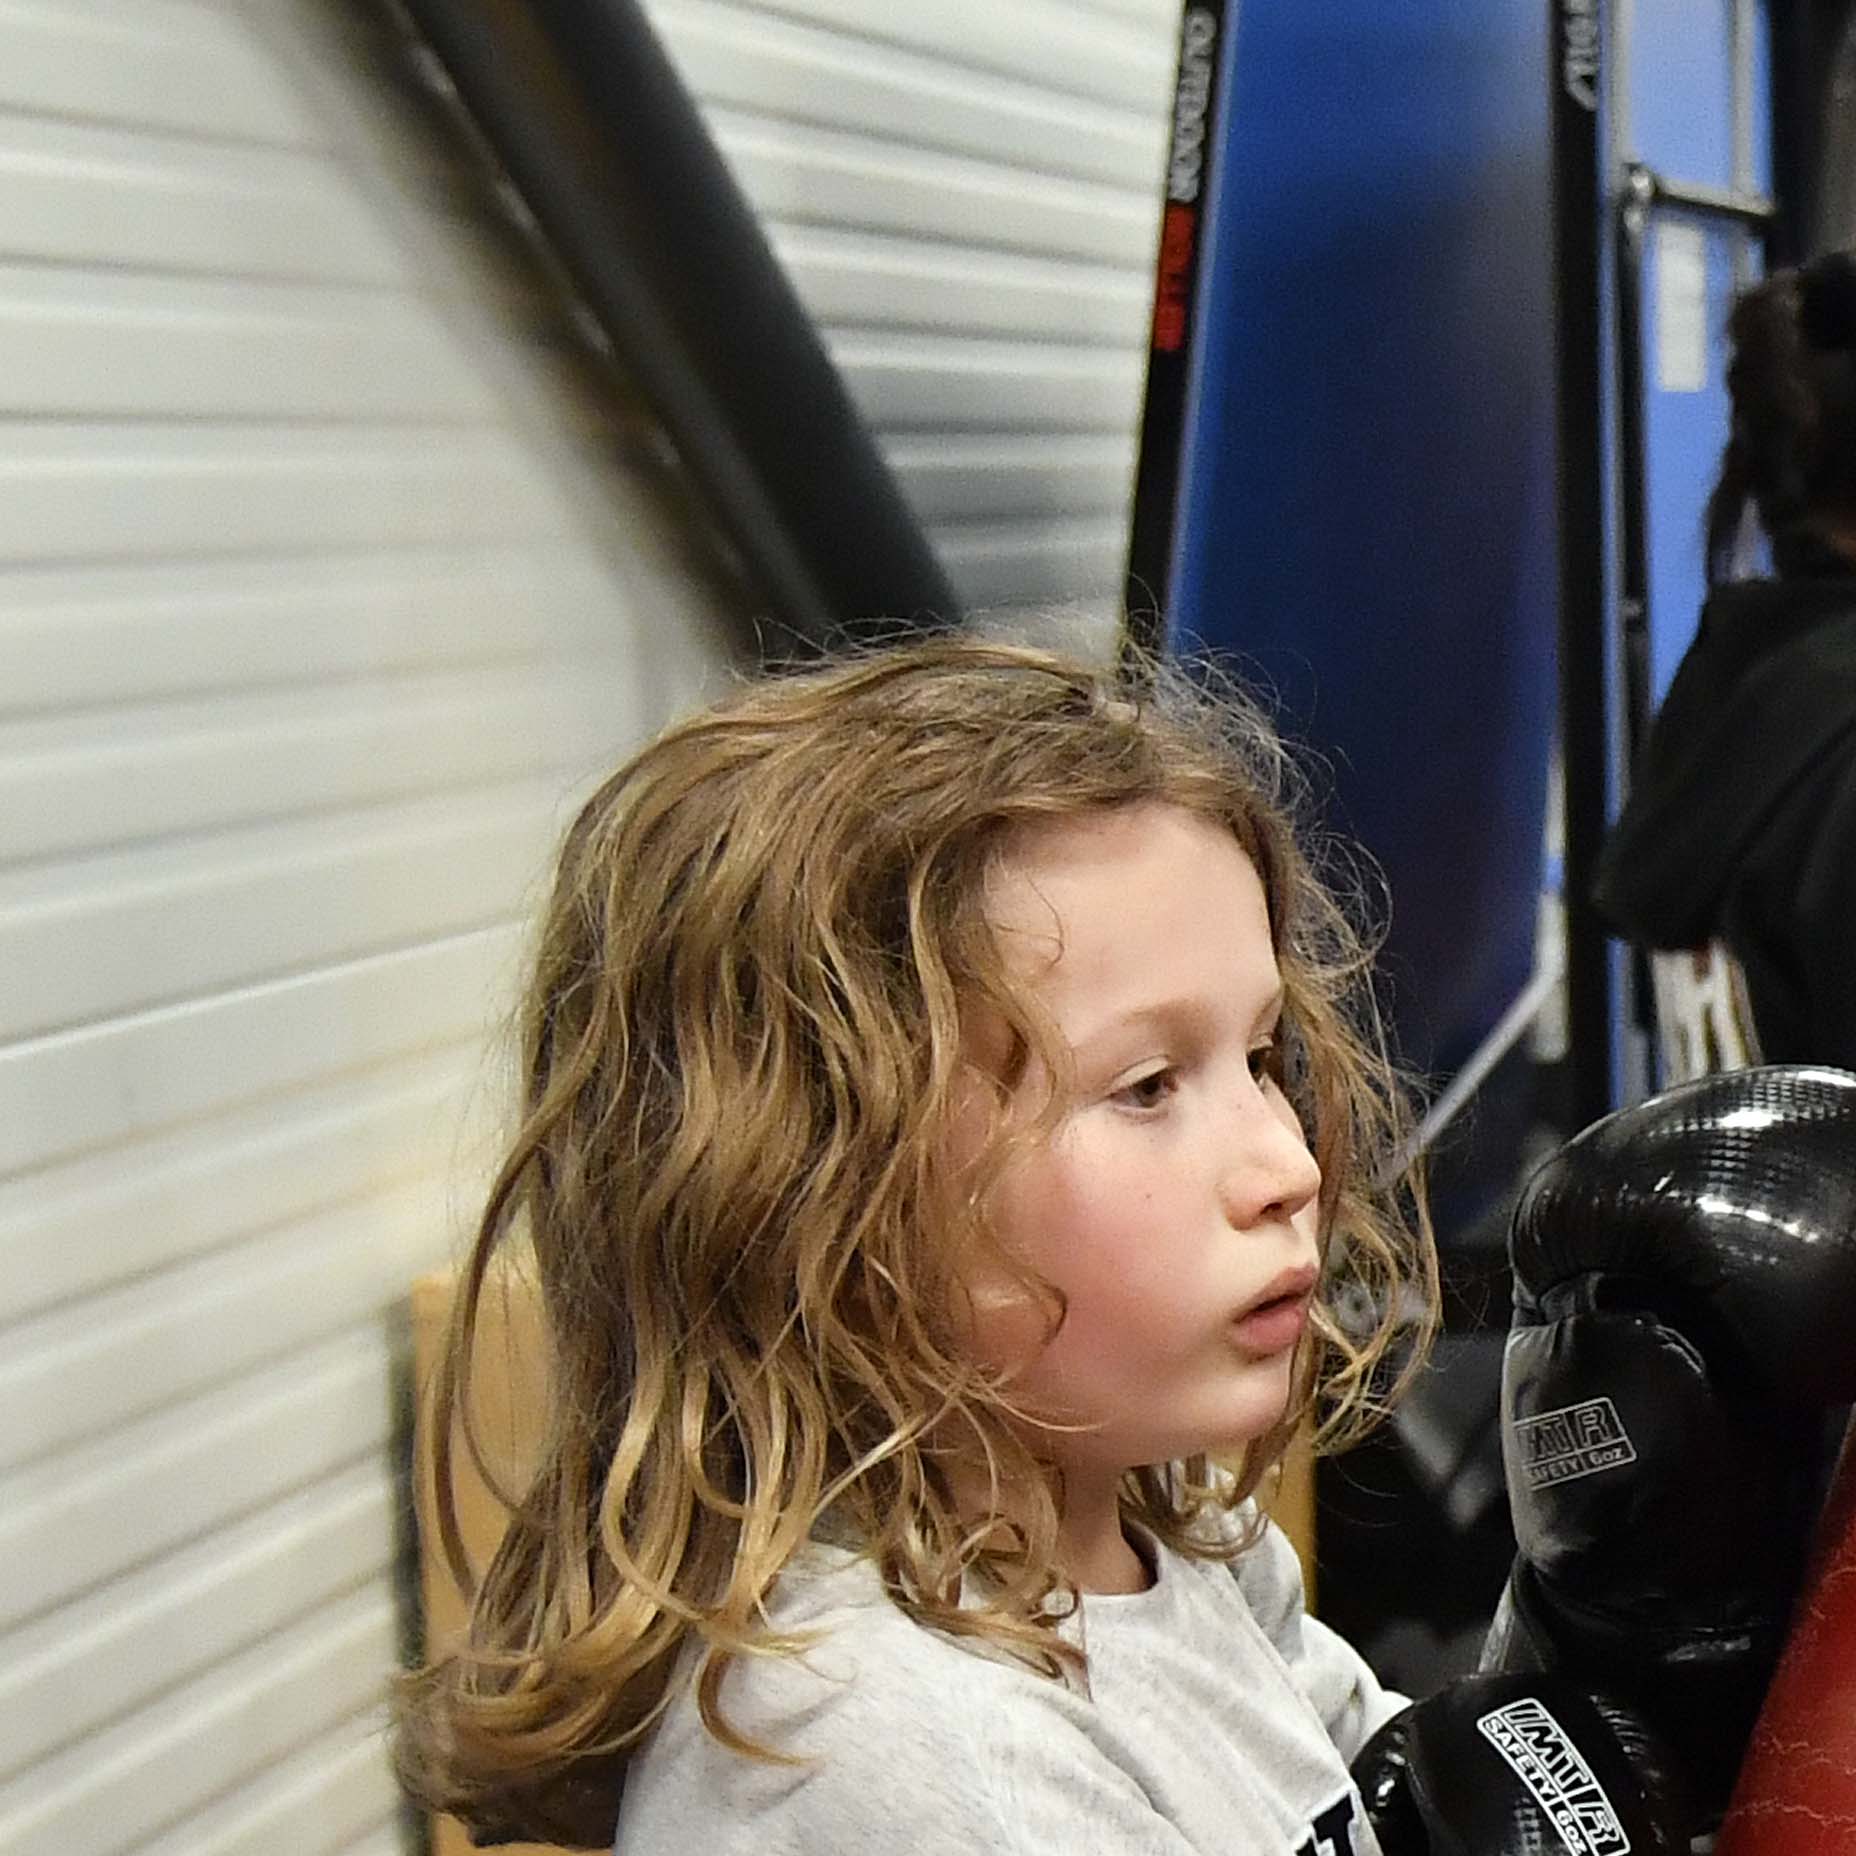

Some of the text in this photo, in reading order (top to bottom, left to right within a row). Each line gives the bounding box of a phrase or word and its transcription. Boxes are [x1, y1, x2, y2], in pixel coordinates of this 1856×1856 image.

[1485, 1715, 1589, 1855] SAFETY 6oz
[1572, 1801, 1620, 1845] R
